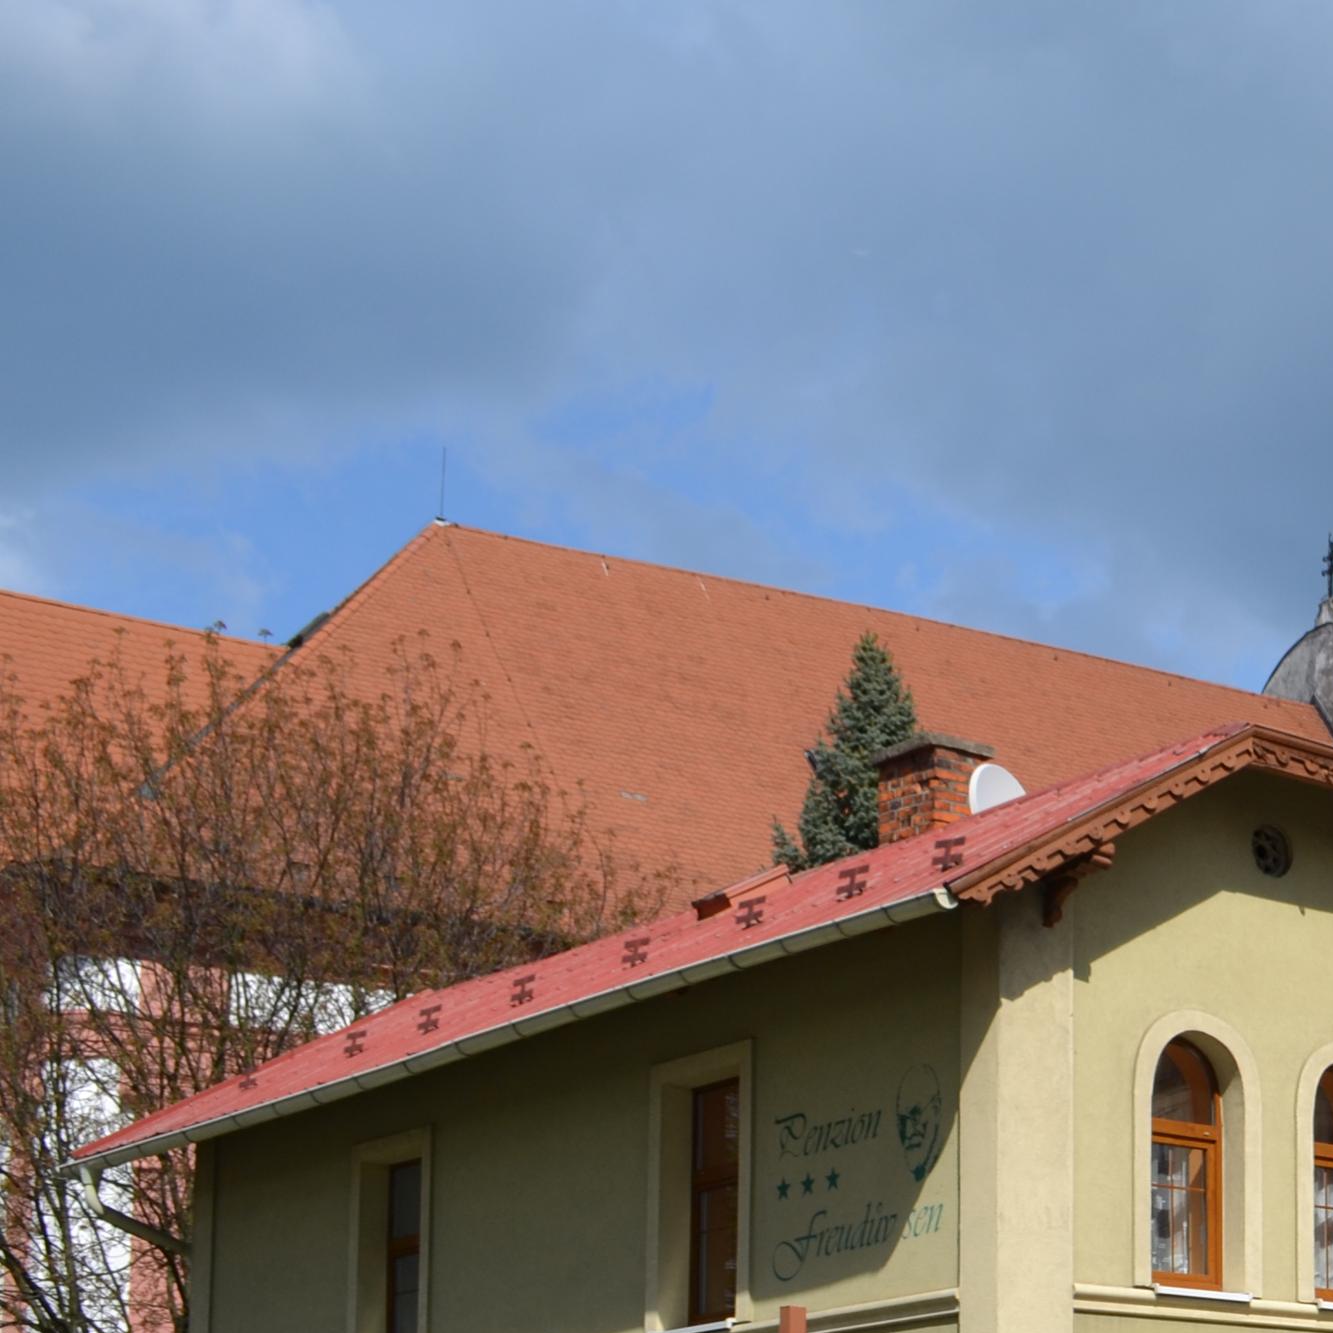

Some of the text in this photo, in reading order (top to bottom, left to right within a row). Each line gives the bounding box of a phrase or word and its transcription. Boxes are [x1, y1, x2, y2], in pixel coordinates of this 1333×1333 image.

[774, 1108, 882, 1158] Penzion
[772, 1202, 944, 1282] Freudův sen
